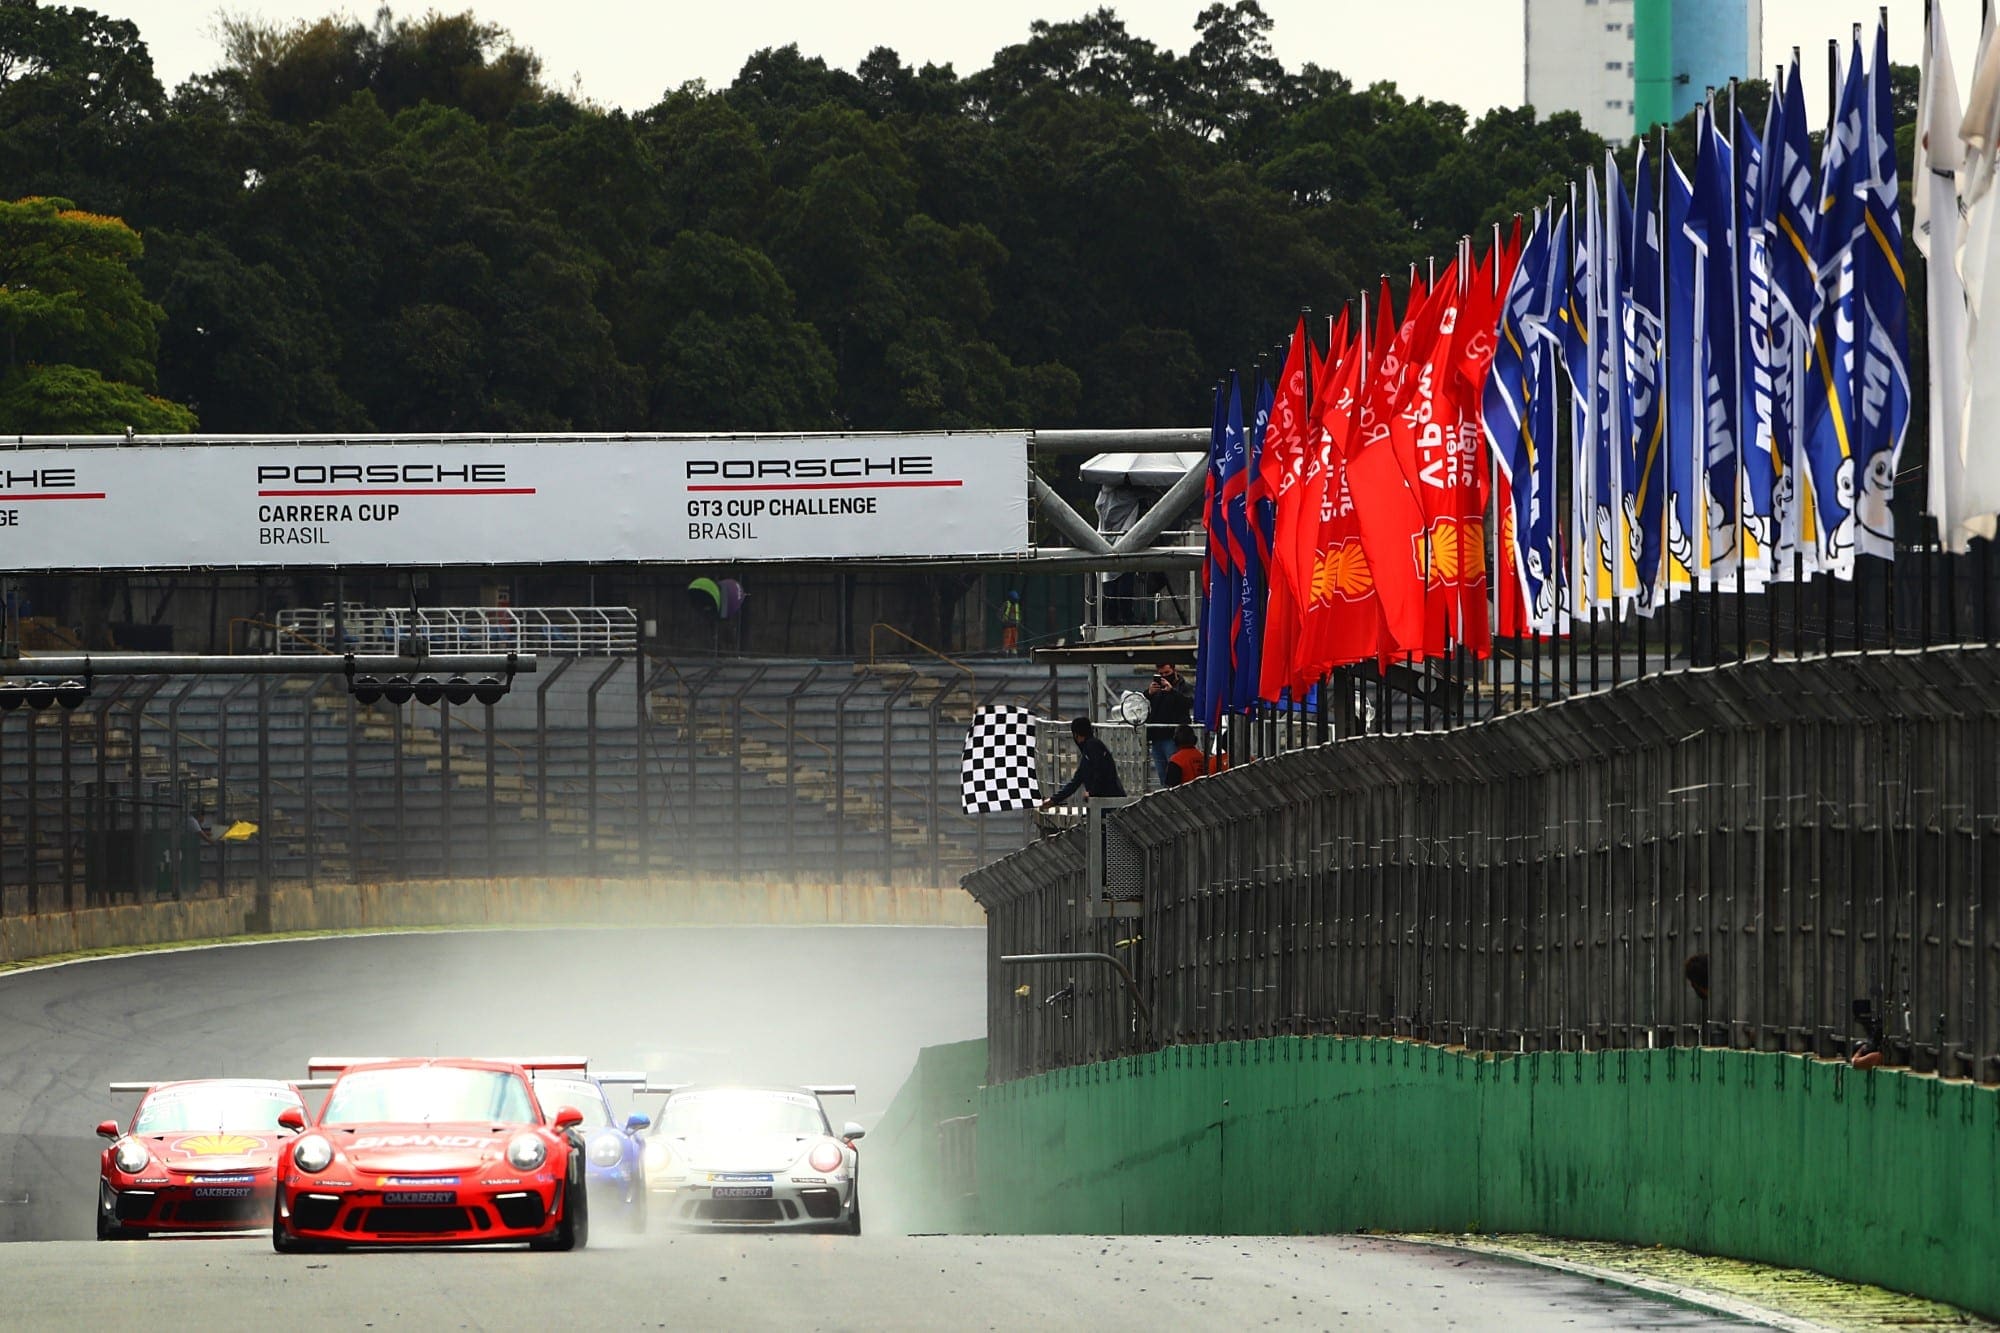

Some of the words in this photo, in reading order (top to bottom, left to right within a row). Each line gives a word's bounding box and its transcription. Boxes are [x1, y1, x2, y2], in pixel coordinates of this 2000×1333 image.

[258, 465, 506, 484] PORSCHE
[687, 457, 932, 479] PORSCHE
[0, 469, 75, 488] HE
[259, 504, 352, 522] CARRERA
[359, 504, 400, 521] CUP
[688, 500, 723, 517] GT3
[727, 499, 764, 517] CUP
[769, 497, 877, 516] CHALLENGE
[260, 526, 329, 545] BRASIL
[688, 522, 757, 540] BRASIL
[195, 1188, 250, 1197] OAKBERRY
[384, 1192, 453, 1203] OAKBERRY
